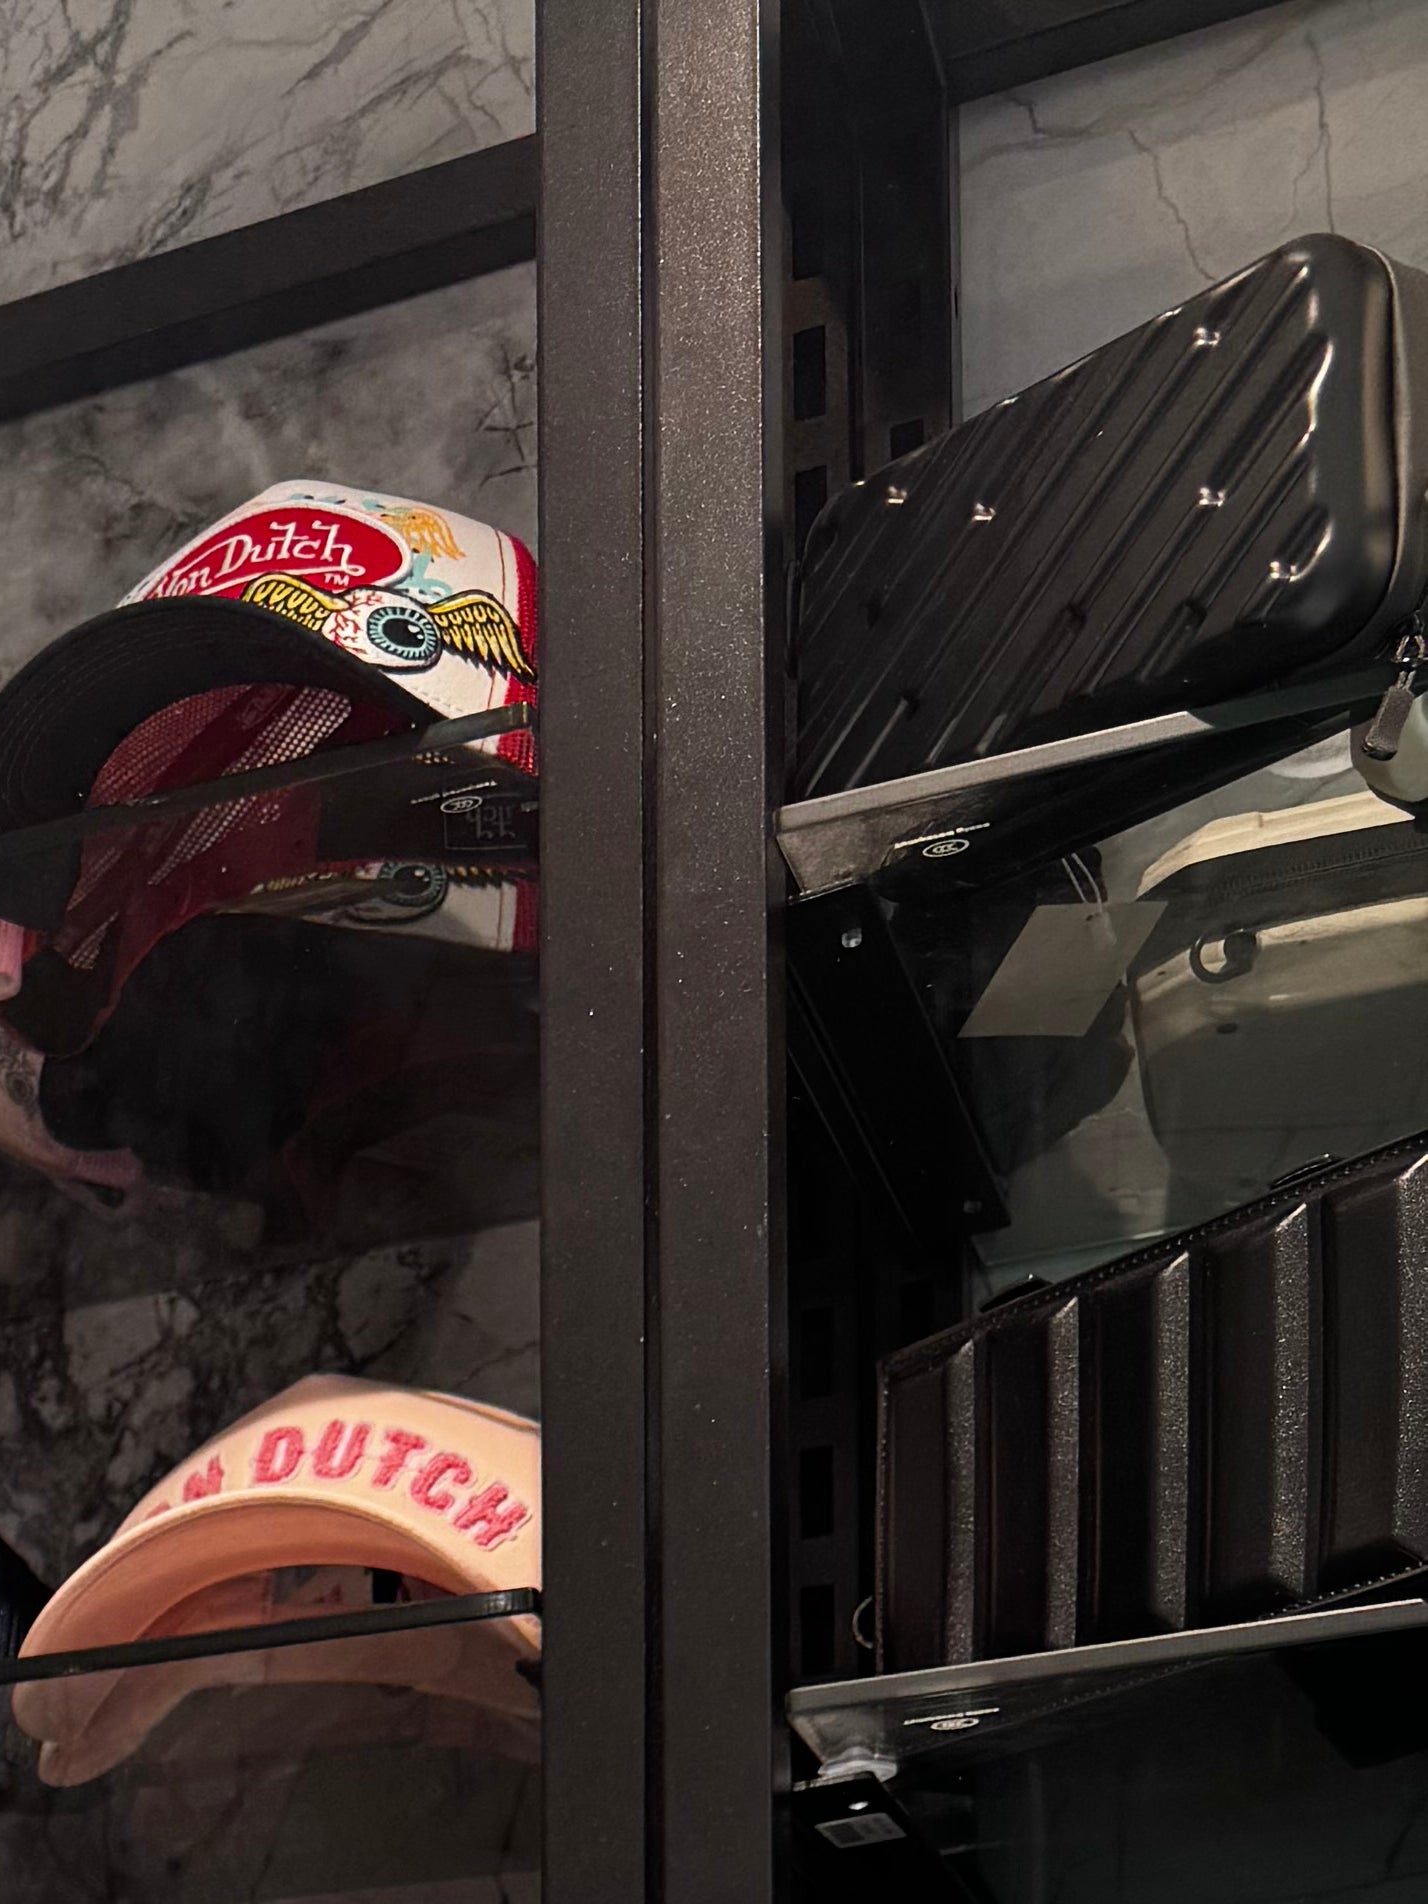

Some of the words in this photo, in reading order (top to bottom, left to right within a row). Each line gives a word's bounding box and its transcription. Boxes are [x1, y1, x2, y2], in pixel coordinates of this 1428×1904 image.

[152, 566, 213, 598] Von
[216, 522, 354, 577] Dutch
[324, 573, 349, 587] TM
[255, 1419, 531, 1549] DUTCH
